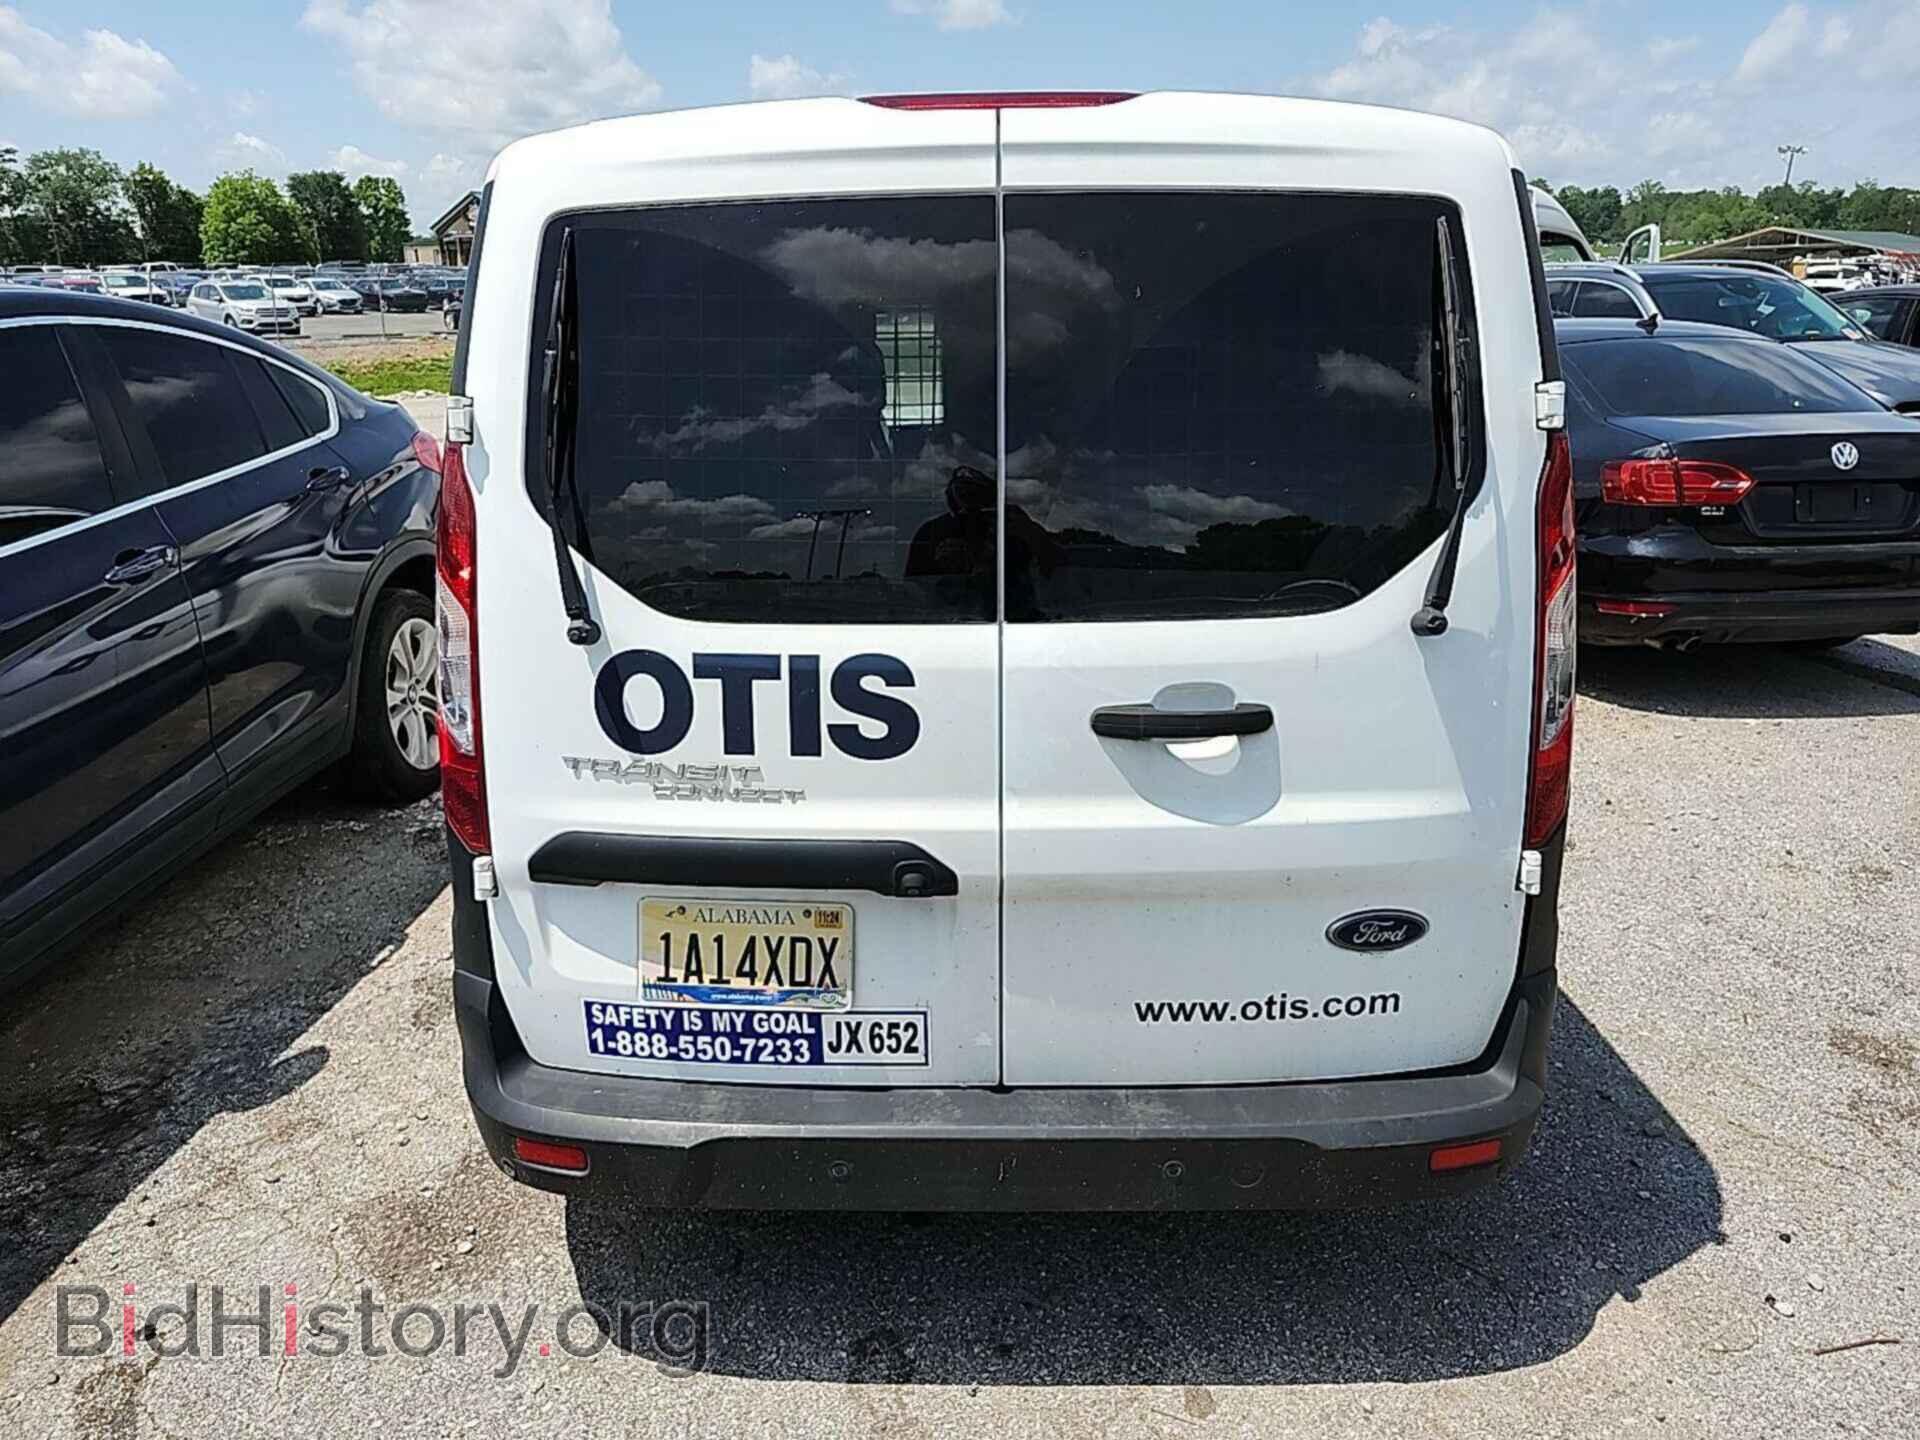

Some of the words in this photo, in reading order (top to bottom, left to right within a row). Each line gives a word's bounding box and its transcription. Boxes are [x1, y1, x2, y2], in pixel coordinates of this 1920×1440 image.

[594, 648, 921, 760] OTIS
[561, 755, 764, 785] TRANSIT
[693, 906, 796, 926] ALABAMA
[1353, 920, 1409, 943] Ford
[656, 931, 840, 989] 1A14XDX
[591, 1003, 675, 1030] SAFETY
[682, 1010, 703, 1031] IS
[711, 1011, 746, 1033] MY
[752, 1012, 816, 1034] GOAL
[1134, 992, 1400, 1022] www.otis.com
[591, 1027, 811, 1064] 1-888-550-7233
[827, 1020, 865, 1054] JX
[868, 1021, 919, 1054] 652
